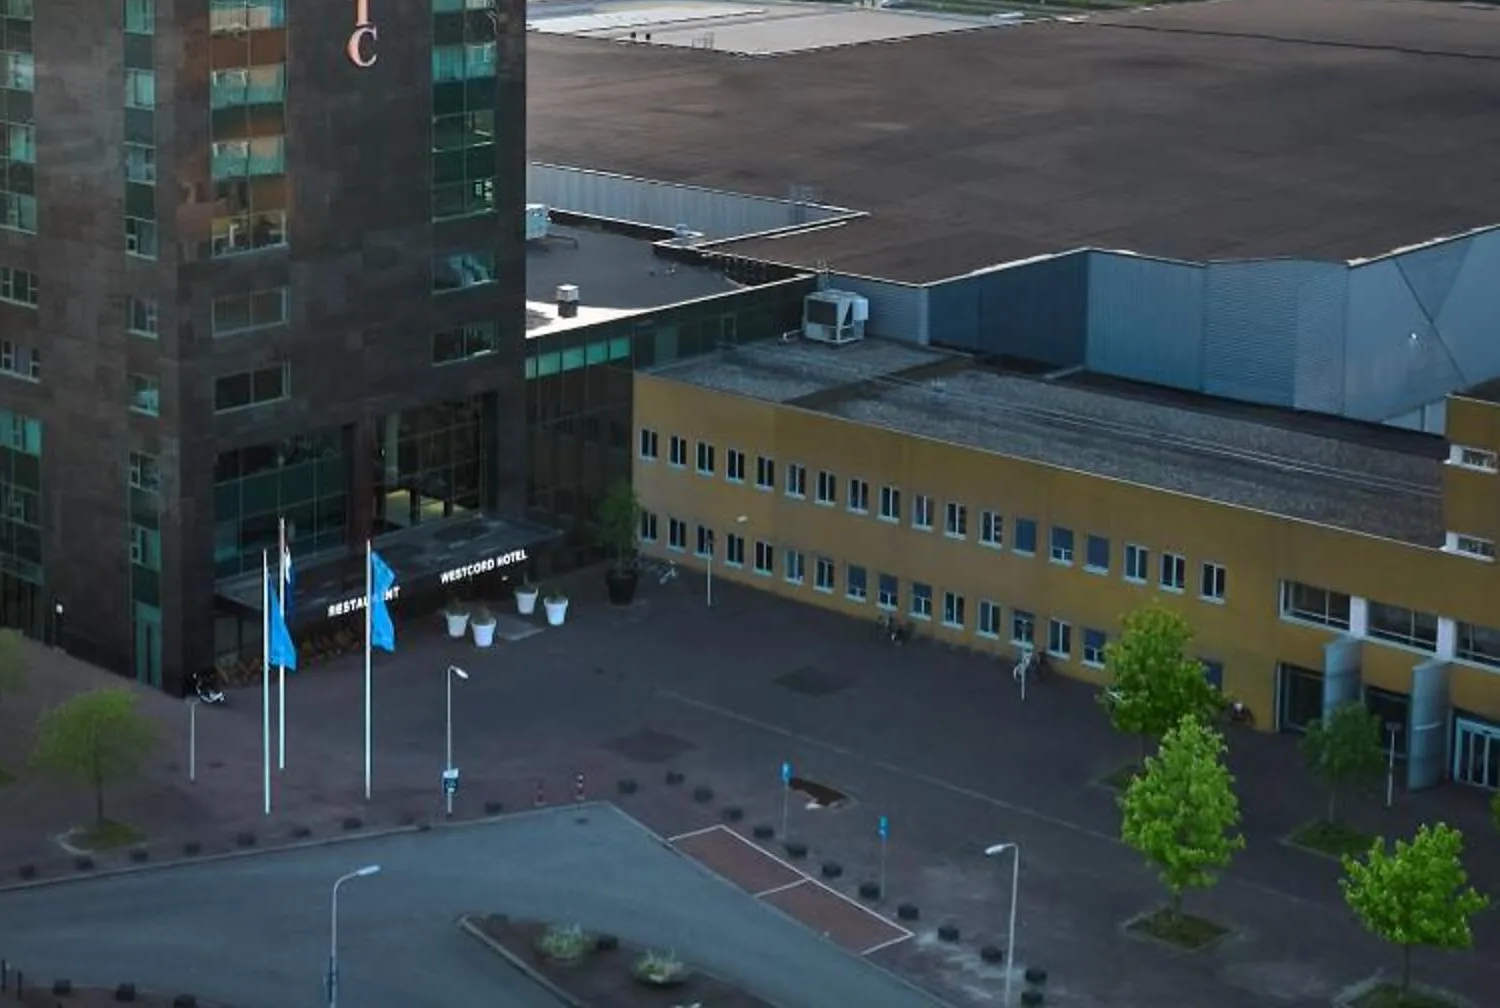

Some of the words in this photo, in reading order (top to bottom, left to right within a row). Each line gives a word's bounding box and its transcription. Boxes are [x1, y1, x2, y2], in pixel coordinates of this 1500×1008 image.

[440, 558, 494, 585] WESTCORD
[497, 549, 528, 567] HOTEL
[327, 585, 401, 618] RESTAUNT
